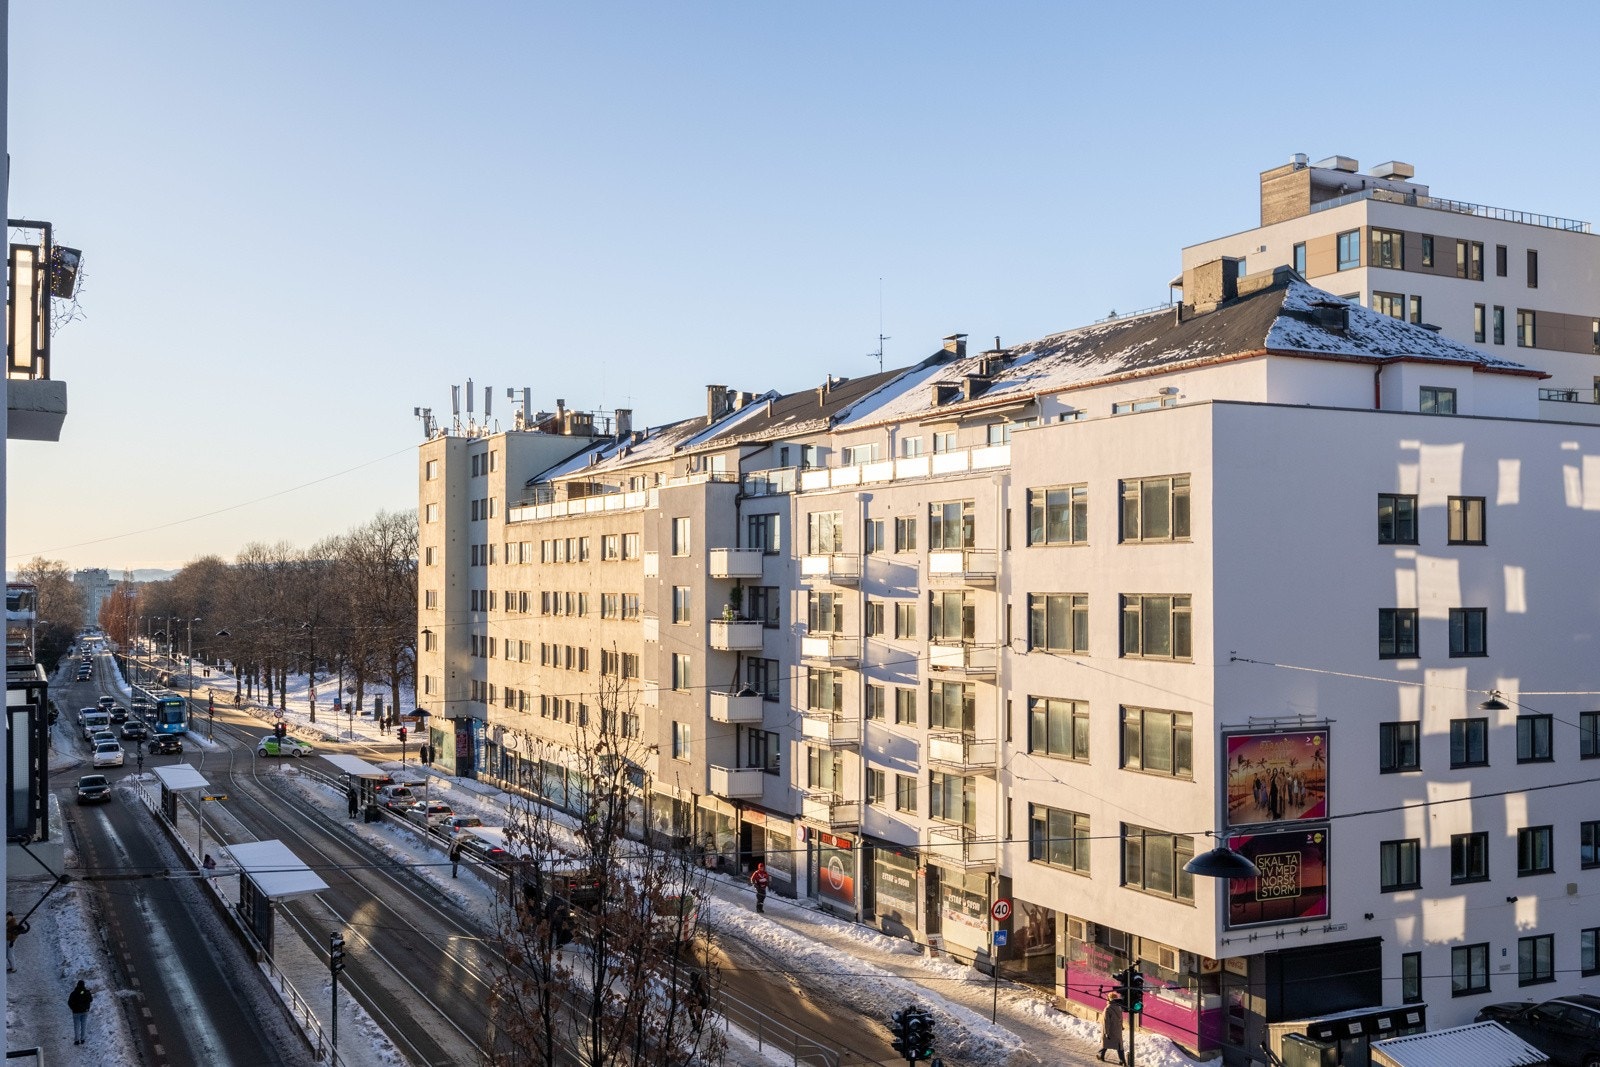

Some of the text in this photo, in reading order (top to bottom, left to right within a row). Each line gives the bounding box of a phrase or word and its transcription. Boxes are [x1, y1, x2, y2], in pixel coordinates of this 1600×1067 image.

[1258, 855, 1298, 868] SKAL TA
[1260, 865, 1297, 877] TV MED
[1261, 875, 1296, 887] NORSK
[1261, 885, 1296, 897] STORM
[995, 904, 1008, 915] 40
